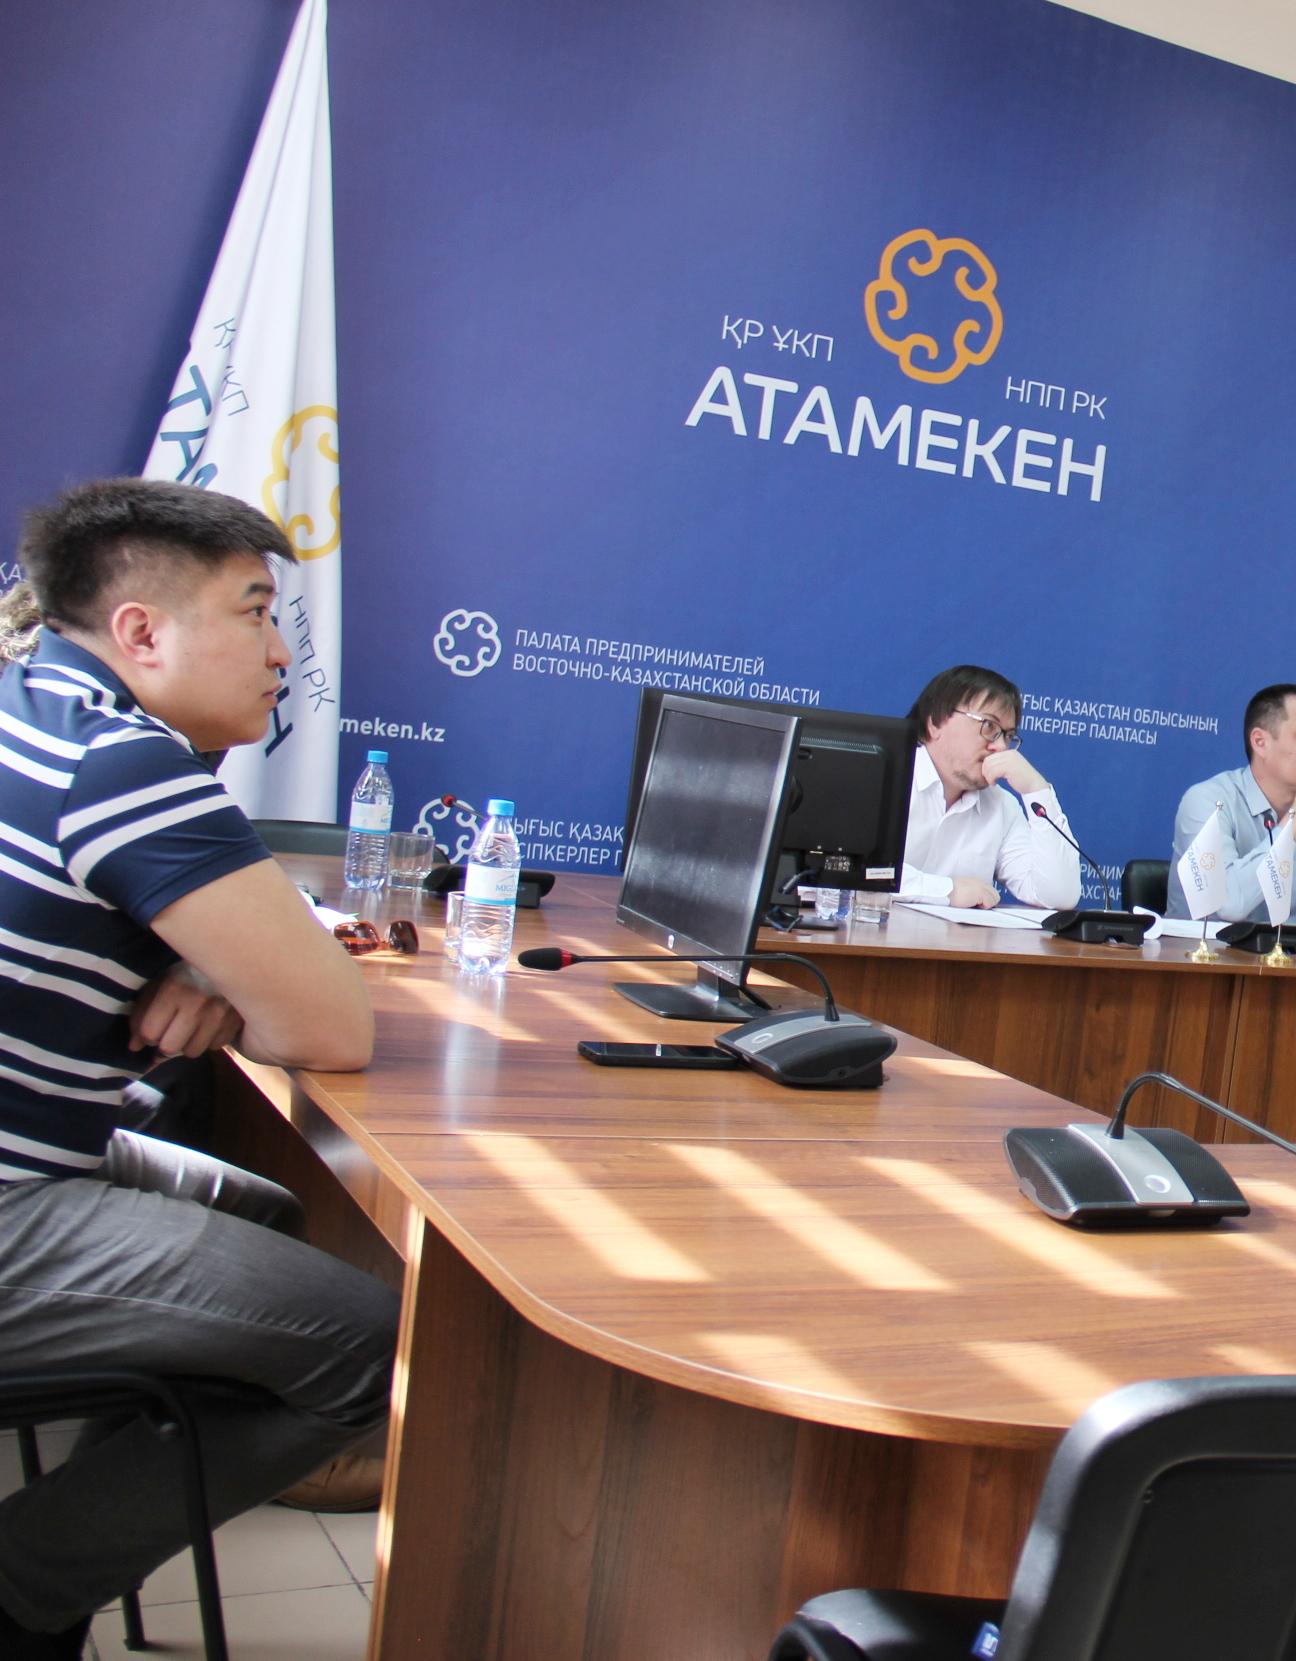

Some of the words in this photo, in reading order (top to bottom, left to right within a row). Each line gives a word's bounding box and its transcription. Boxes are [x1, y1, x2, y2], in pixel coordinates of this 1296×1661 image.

[721, 314, 764, 350] ҚР
[1005, 376, 1065, 411] НПП
[1071, 390, 1108, 420] РК
[685, 365, 1108, 503] АТАМЕКЕН
[515, 628, 582, 654] ПАЛАТА
[585, 638, 765, 677] ПРЕДПРИНИМАТЕЛЕЙ
[512, 653, 745, 697] ВОСТОЧНО-КАЗАХСТАНСКОЙ
[748, 681, 821, 706] ОБЛАСТИ
[340, 716, 446, 743] meken.kz
[1020, 715, 1087, 737] ІПКЕРЛЕР
[1088, 723, 1158, 746] ПАЛАТАСЫ
[1053, 697, 1130, 721] ҚАЗАҚСТАН
[1133, 707, 1219, 736] ОБЛЫСЫНЫҢ
[513, 817, 564, 838] ЫҒЫС
[569, 822, 625, 846] ҚАЗАҚ
[519, 842, 610, 866] СІПКЕРЛЕР
